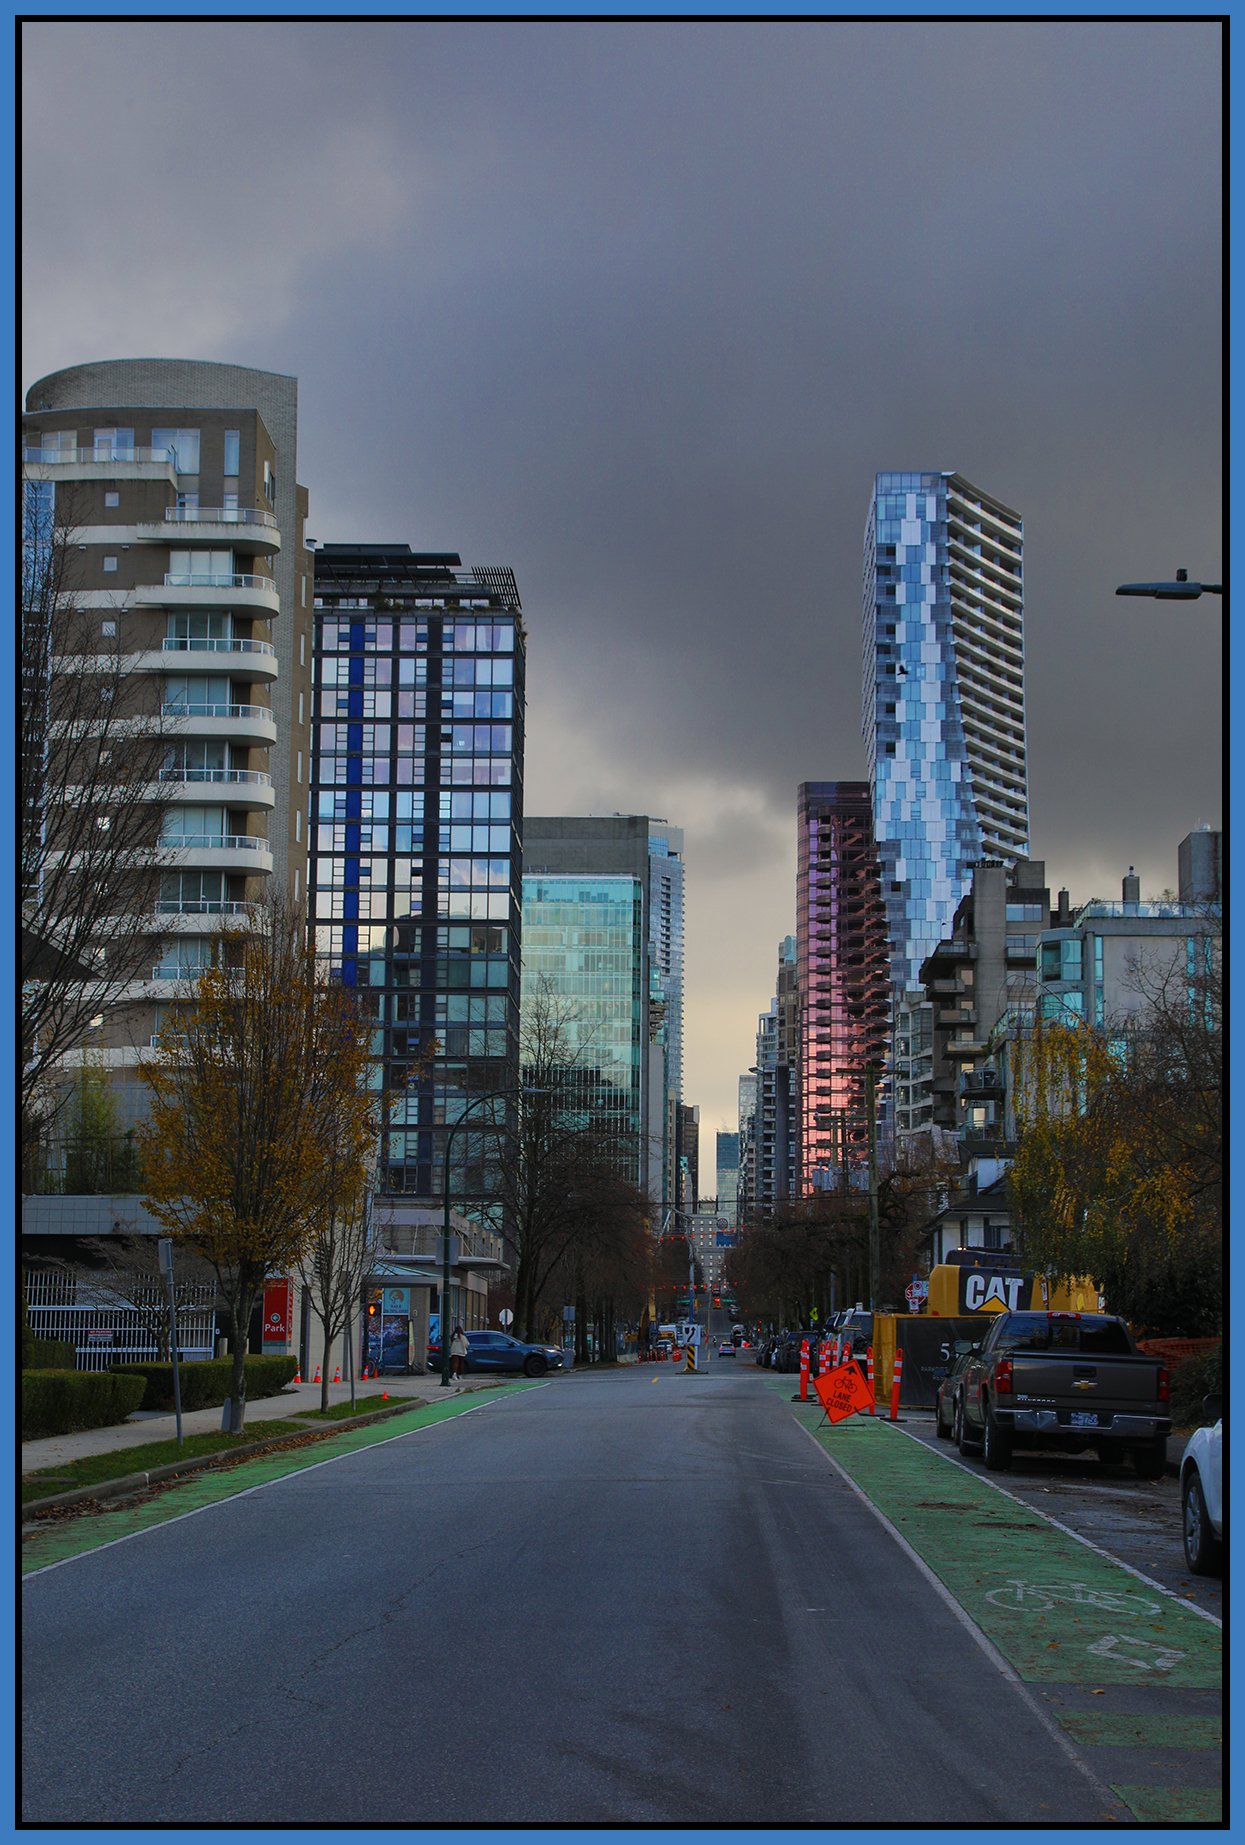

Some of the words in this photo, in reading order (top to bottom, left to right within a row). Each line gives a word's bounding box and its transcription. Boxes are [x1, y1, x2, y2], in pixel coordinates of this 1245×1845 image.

[965, 1274, 1024, 1312] CAT
[264, 1323, 285, 1332] Park
[833, 1390, 852, 1403] LANE
[826, 1397, 852, 1413] CLOSED
